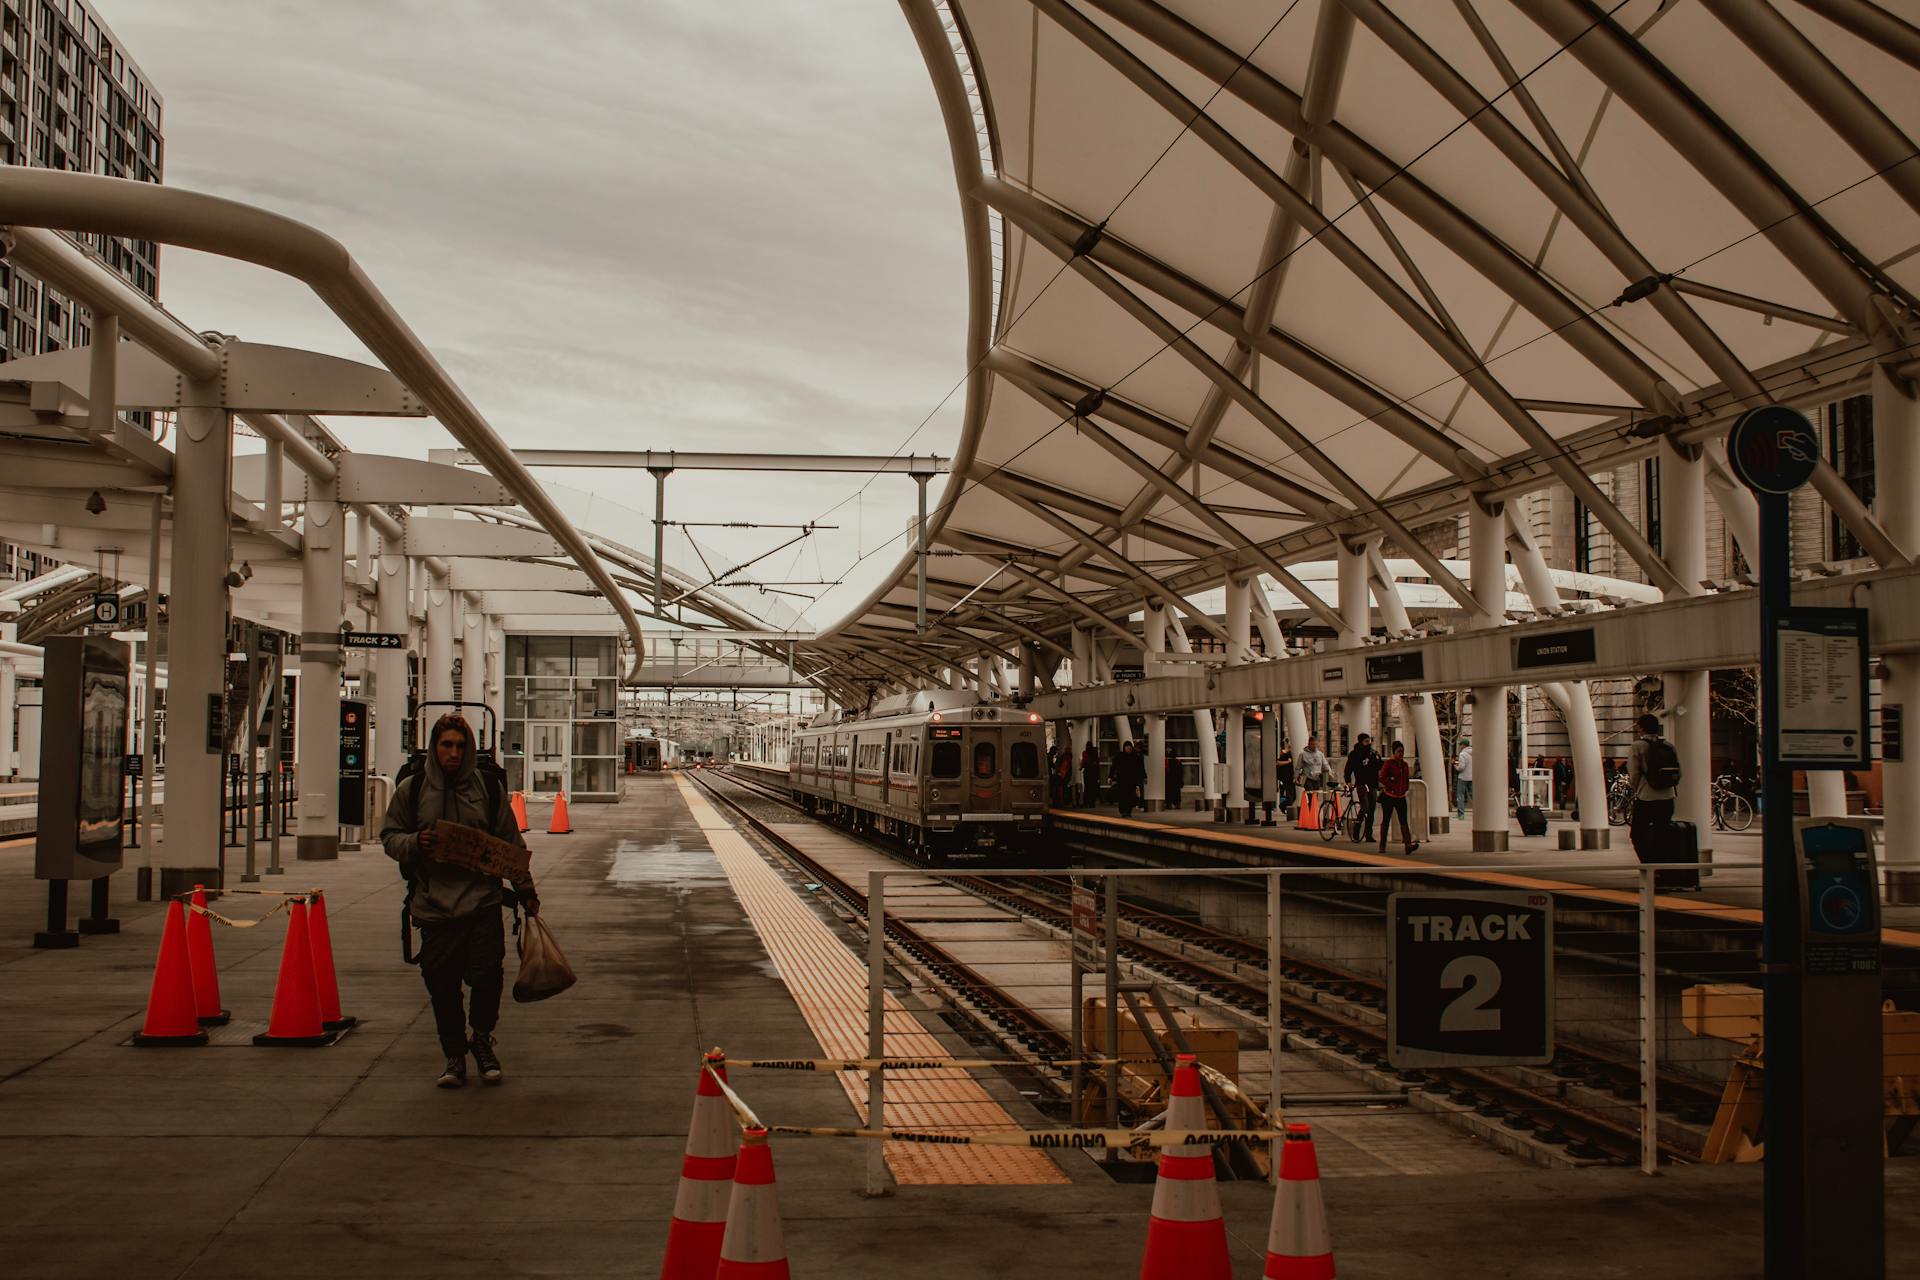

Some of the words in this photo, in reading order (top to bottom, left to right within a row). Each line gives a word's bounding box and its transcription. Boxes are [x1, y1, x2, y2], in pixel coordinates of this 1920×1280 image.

[102, 605, 112, 618] H
[348, 636, 378, 645] TRACK
[380, 636, 390, 646] 2
[1536, 648, 1549, 656] UNION
[1550, 645, 1568, 655] STATION
[1528, 895, 1548, 906] RTD
[1407, 914, 1532, 942] TRACK
[1439, 954, 1503, 1032] 2
[1029, 1133, 1107, 1148] CAUTION
